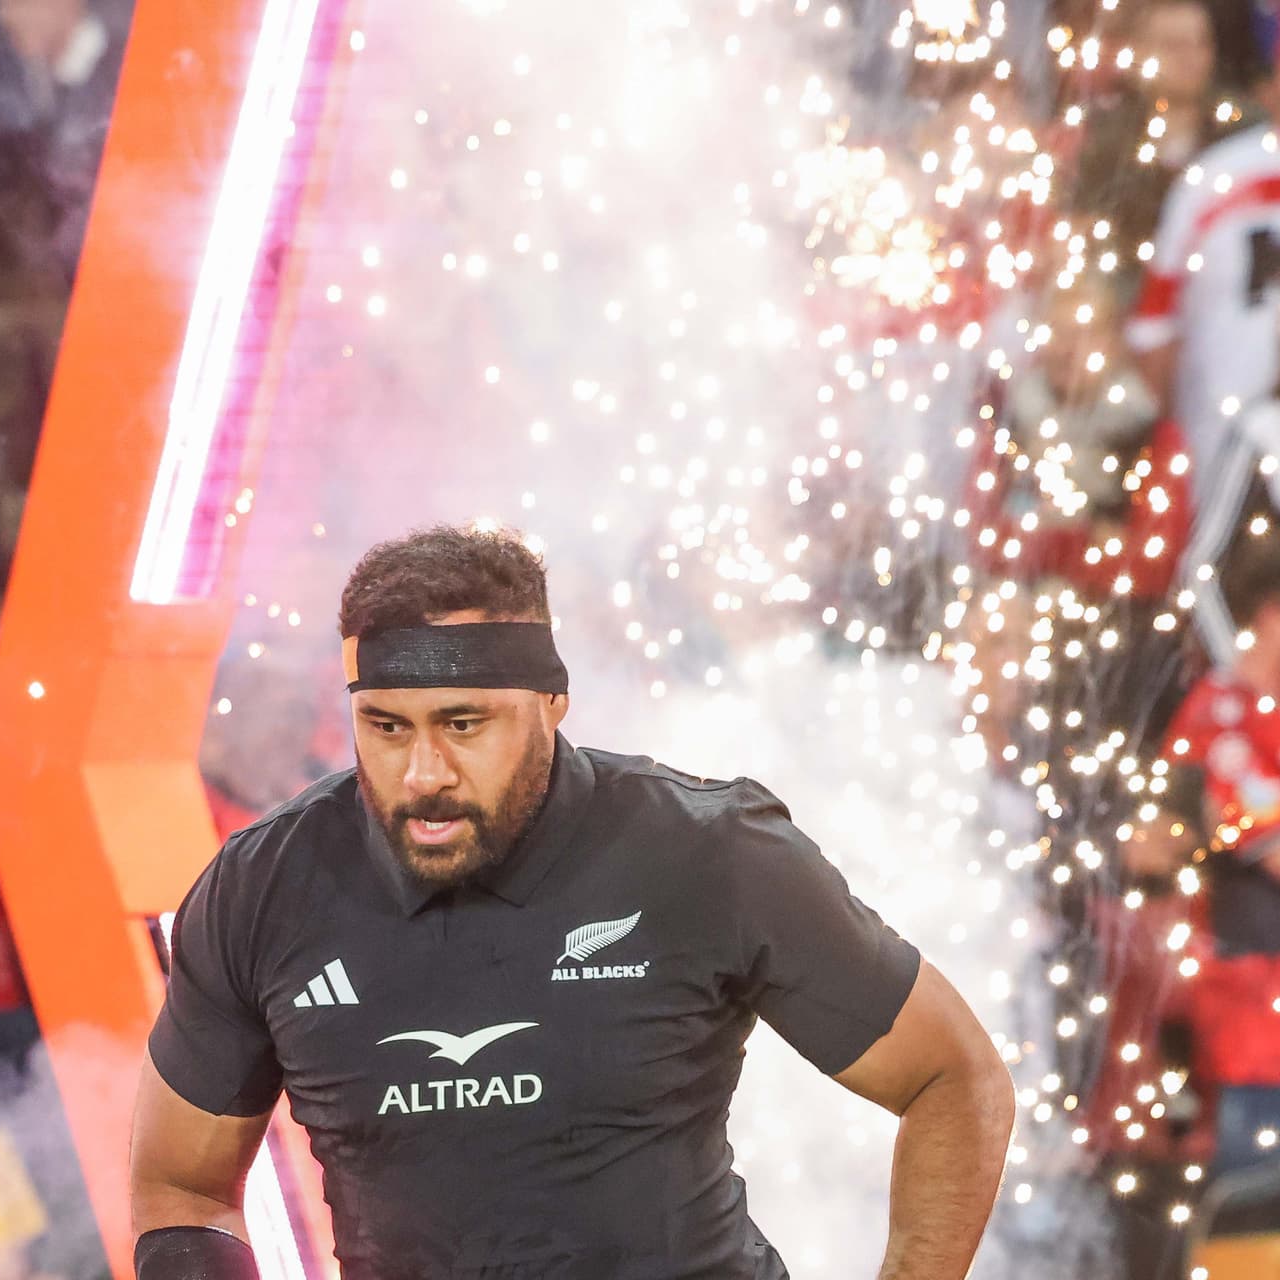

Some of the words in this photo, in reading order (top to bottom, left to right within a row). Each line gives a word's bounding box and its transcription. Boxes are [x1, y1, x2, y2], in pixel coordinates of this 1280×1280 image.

[551, 968, 579, 981] ALL
[582, 964, 645, 979] BLACKS
[377, 1073, 543, 1115] ALTRAD
